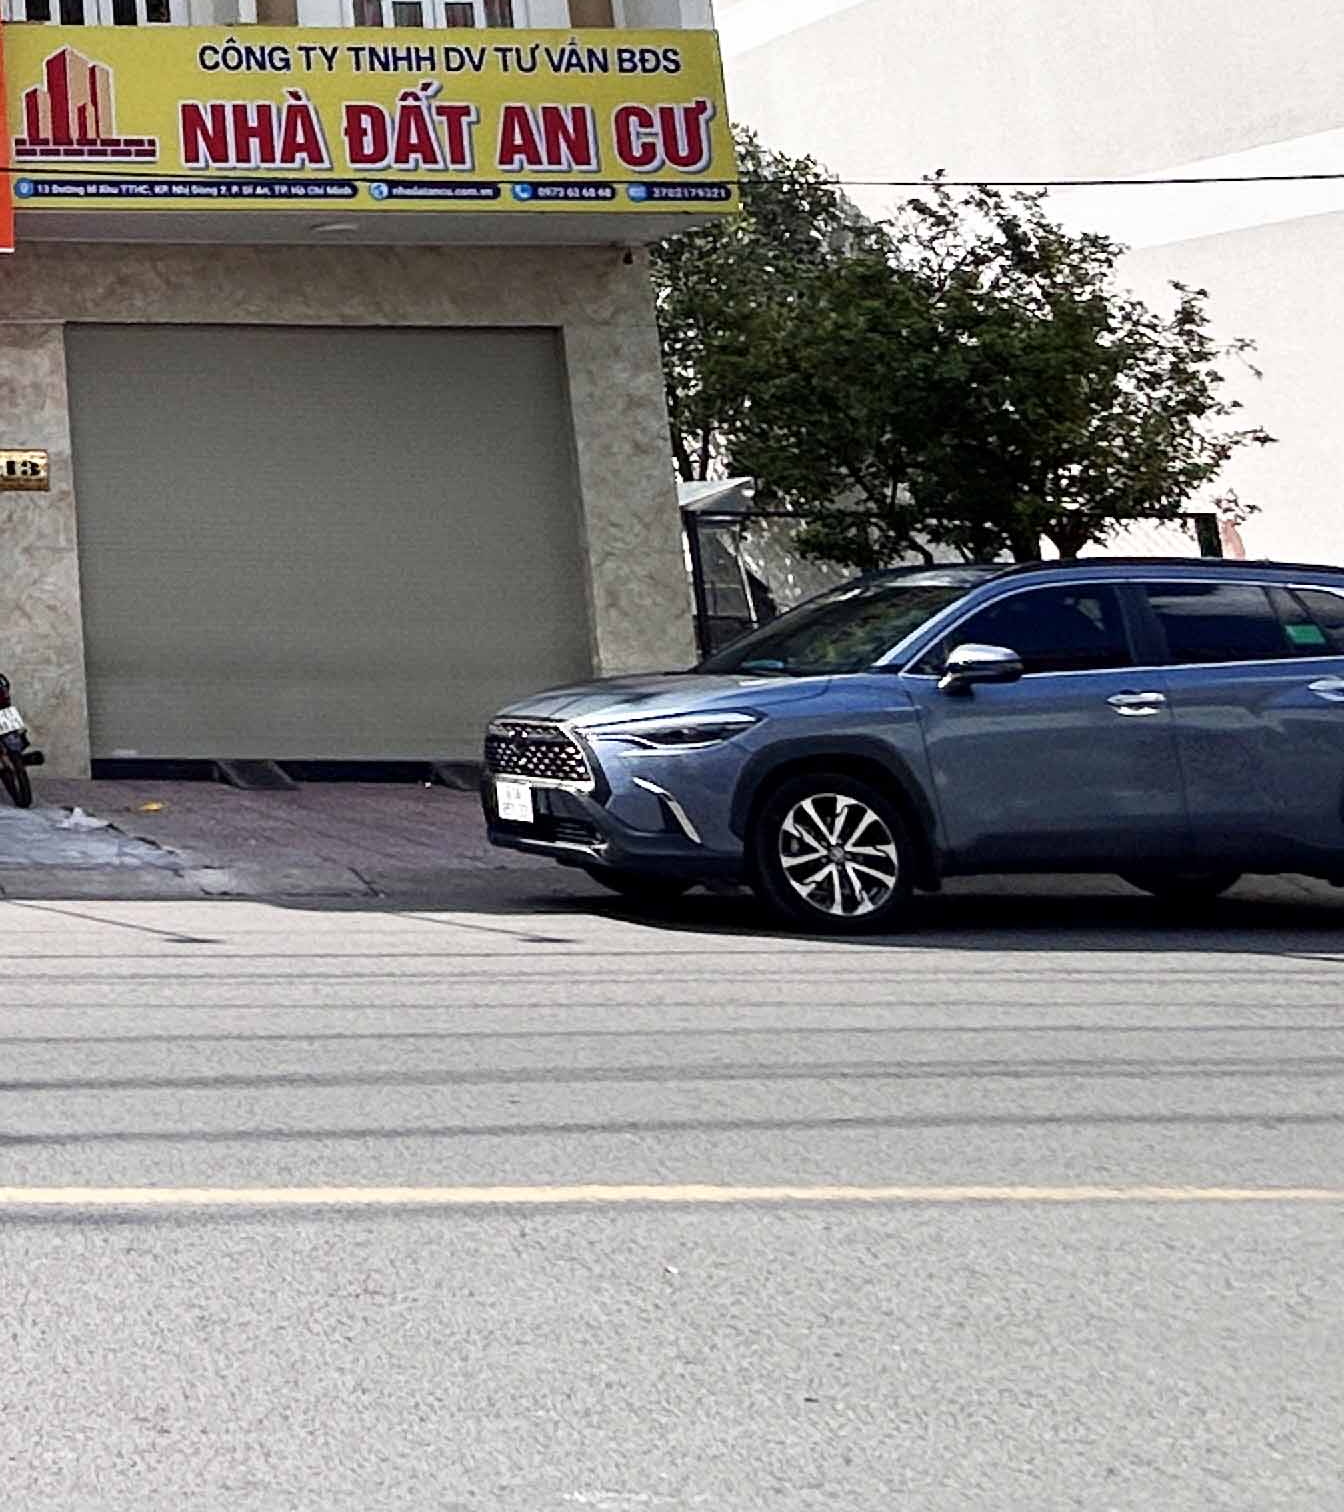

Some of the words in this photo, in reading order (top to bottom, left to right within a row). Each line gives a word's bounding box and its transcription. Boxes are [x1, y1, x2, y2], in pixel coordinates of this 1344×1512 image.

[196, 38, 292, 74] CÔNG
[296, 47, 339, 73] TY
[344, 47, 439, 73] TNHH
[445, 47, 485, 74] DV
[495, 44, 543, 74] TƯ
[546, 34, 610, 74] VẤN
[616, 47, 683, 75] BĐS
[180, 89, 330, 172] NHÀ
[341, 81, 475, 172] ĐẤT
[499, 103, 603, 170] AN
[613, 97, 717, 170] CƯ
